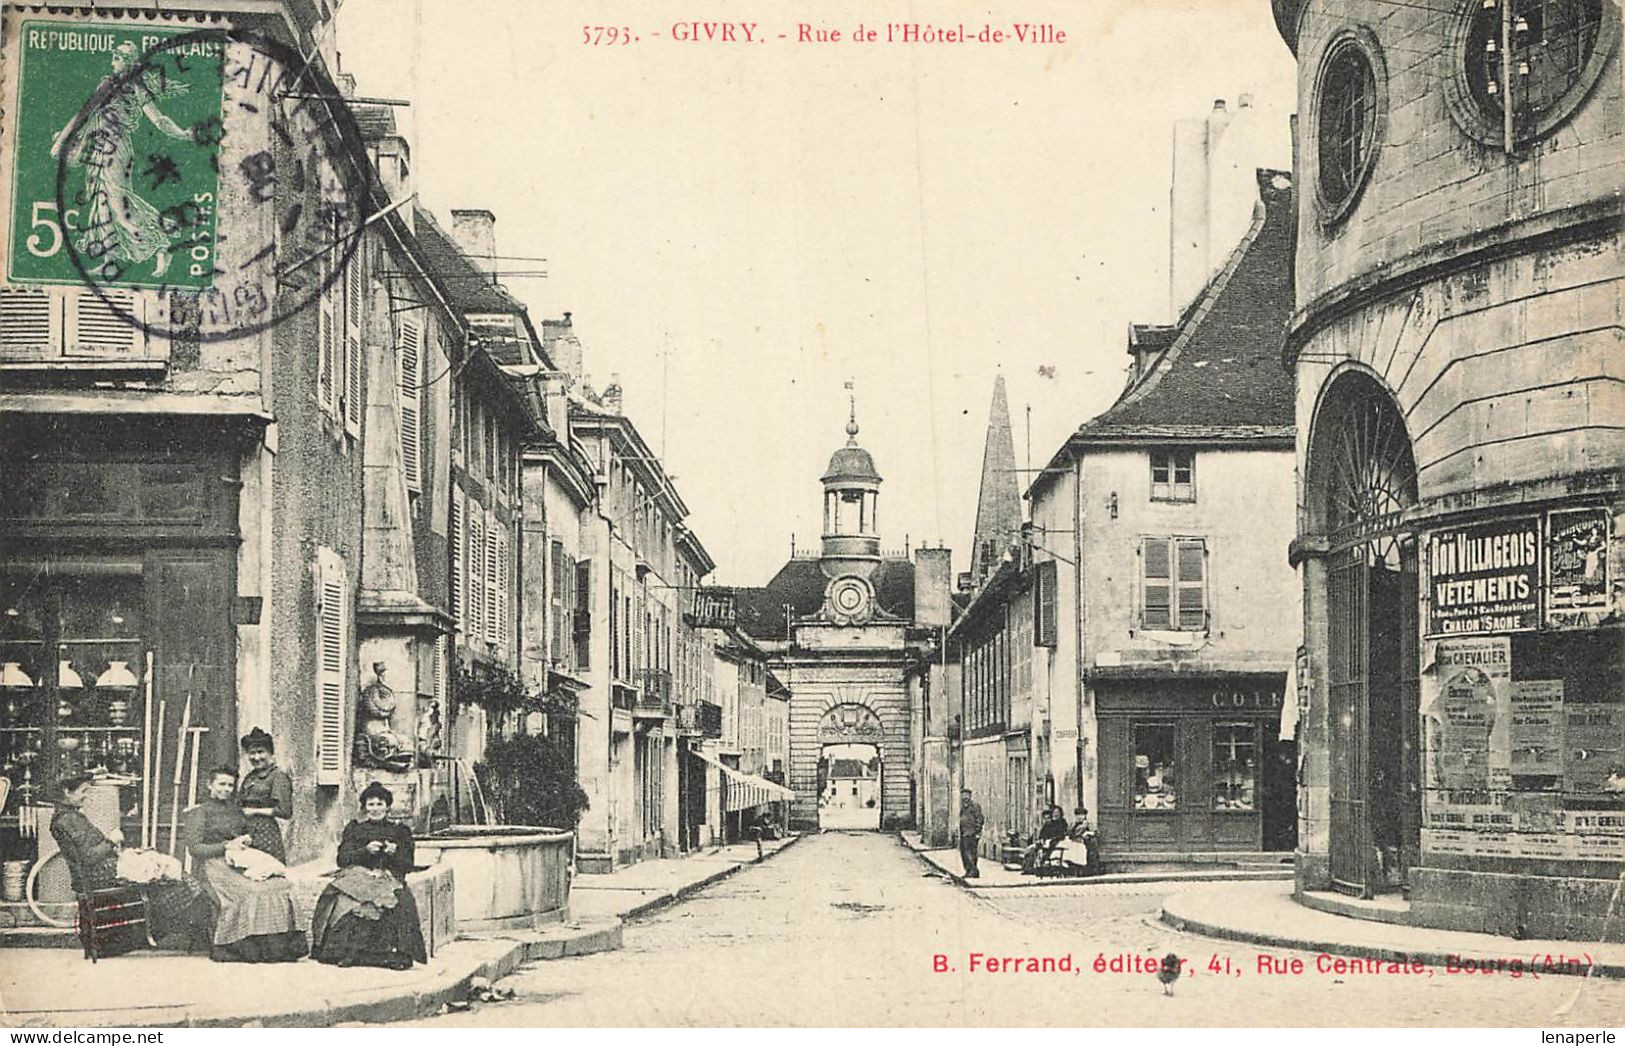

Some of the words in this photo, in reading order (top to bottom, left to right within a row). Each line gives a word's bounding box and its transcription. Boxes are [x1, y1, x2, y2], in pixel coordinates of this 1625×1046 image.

[1458, 531, 1536, 573] VILLAGEOIS
[1437, 574, 1530, 607] VÊTEMENTS
[1443, 619, 1480, 633] CHALON
[1453, 650, 1506, 666] CHEVALIER
